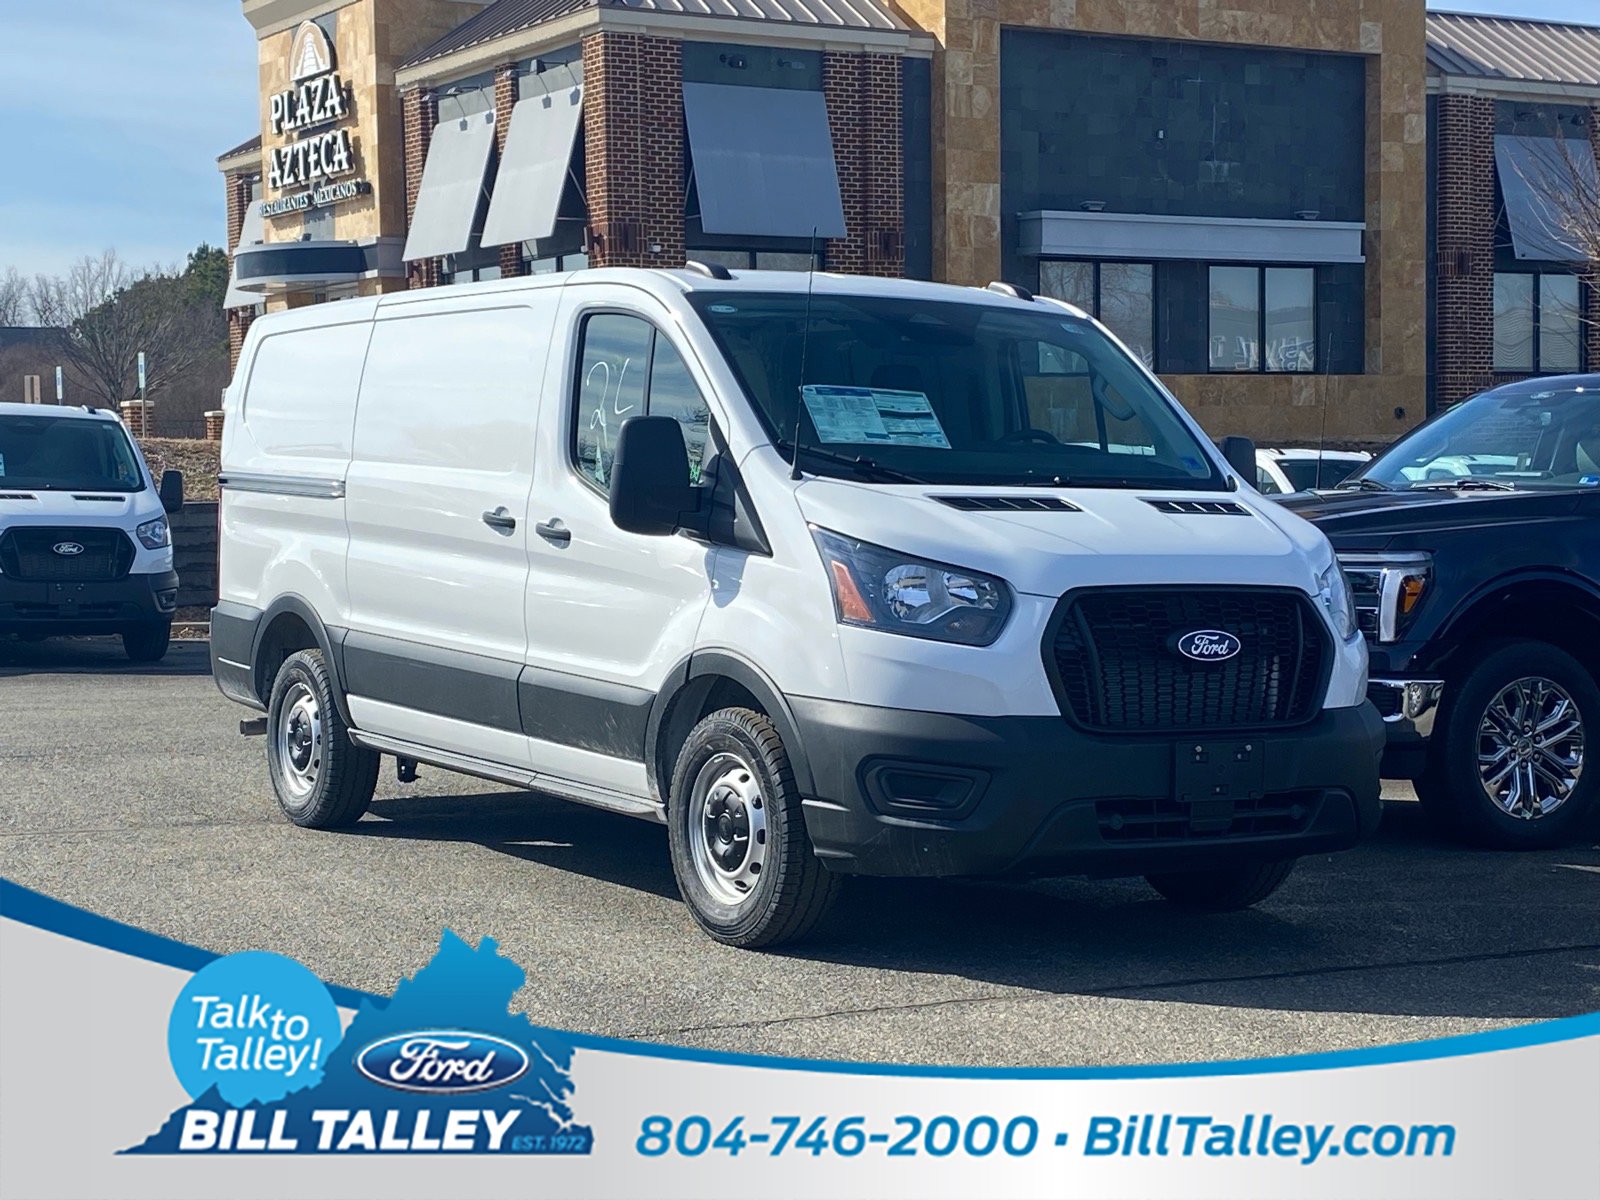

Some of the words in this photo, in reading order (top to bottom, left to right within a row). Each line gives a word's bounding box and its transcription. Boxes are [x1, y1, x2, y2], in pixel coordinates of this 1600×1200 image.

[270, 75, 343, 134] PLAZA
[268, 130, 349, 188] AZTECA
[312, 181, 358, 206] MEXICANOS
[59, 542, 79, 554] Ford
[1191, 634, 1230, 655] Ford
